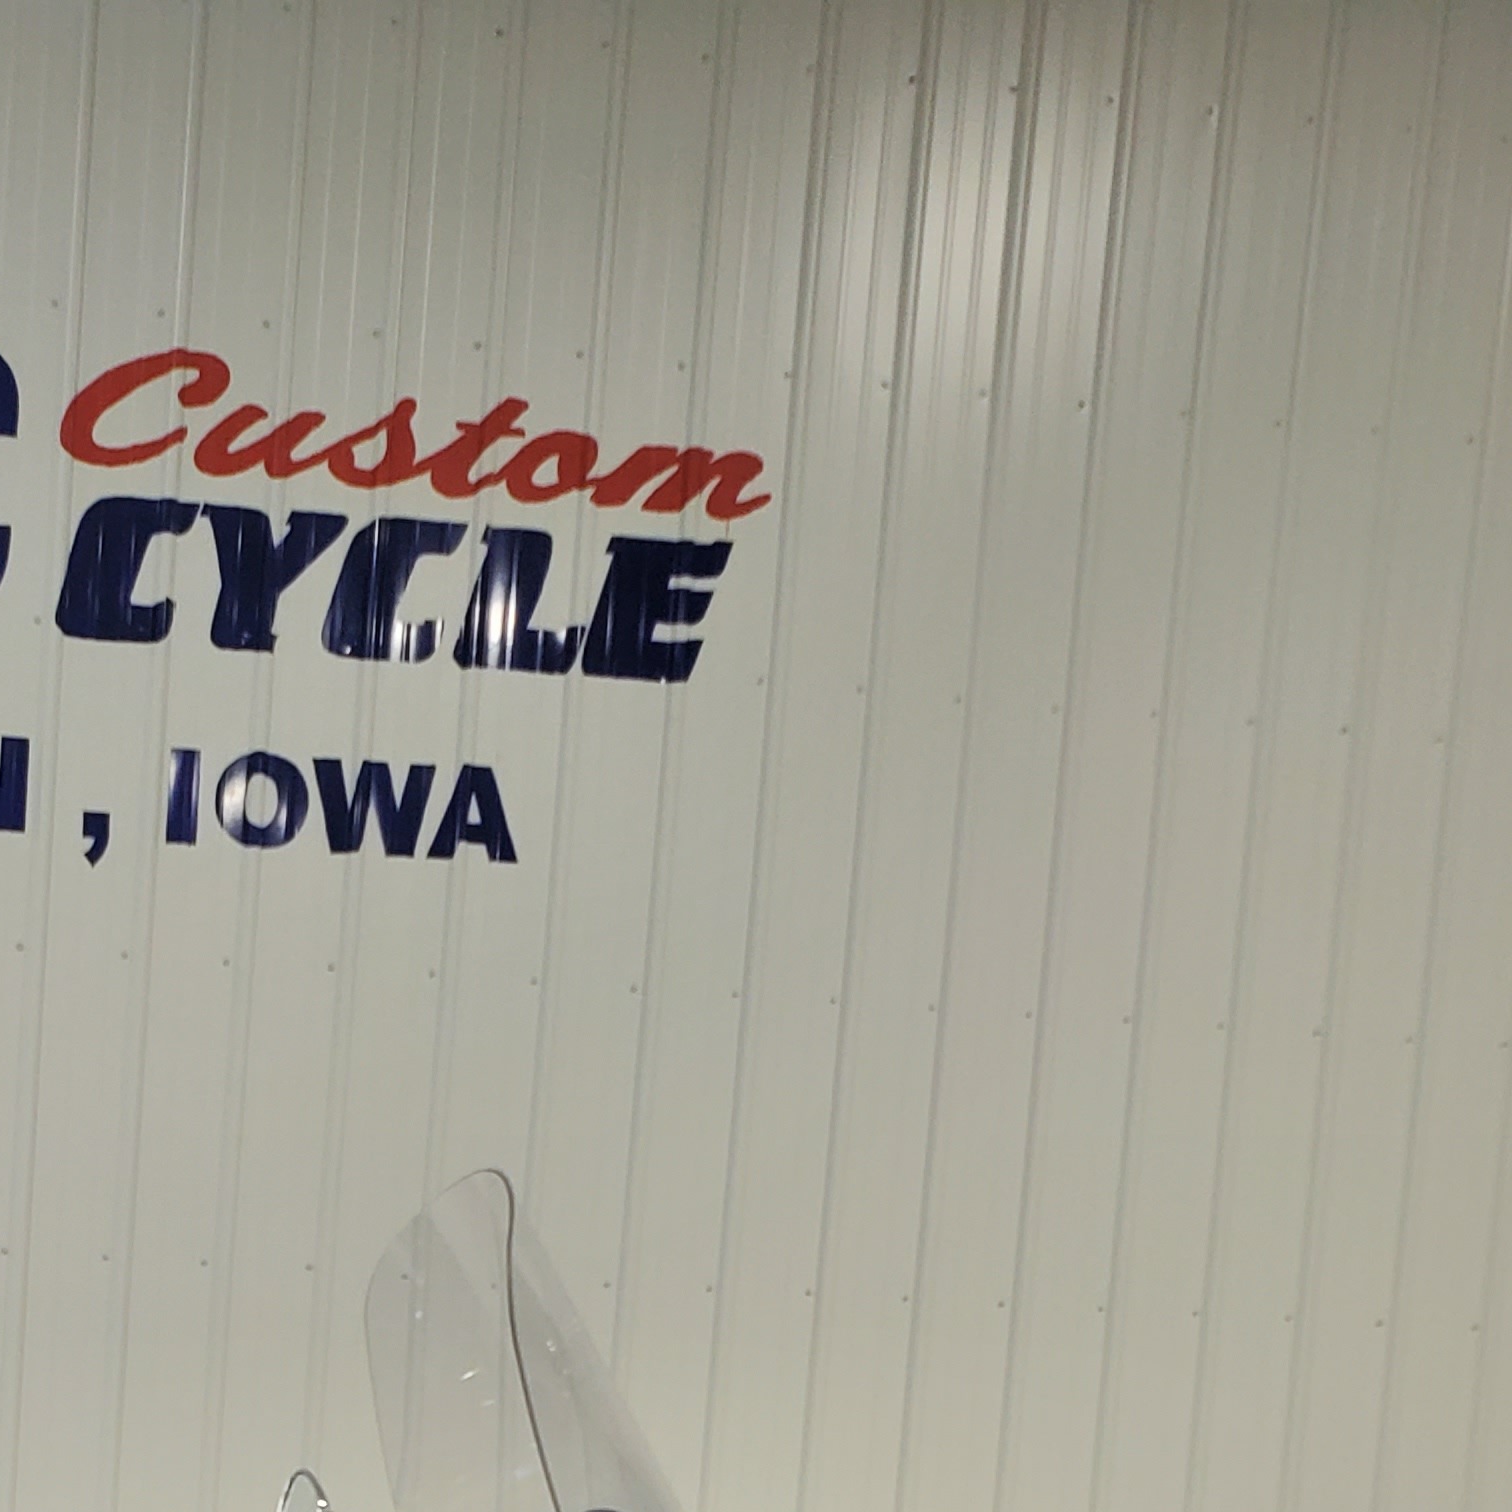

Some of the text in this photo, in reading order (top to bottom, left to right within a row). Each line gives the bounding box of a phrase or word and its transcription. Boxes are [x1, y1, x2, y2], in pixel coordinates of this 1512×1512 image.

[60, 348, 772, 520] Custom
[54, 496, 733, 684] CYCLE
[165, 748, 518, 864] IOWA
